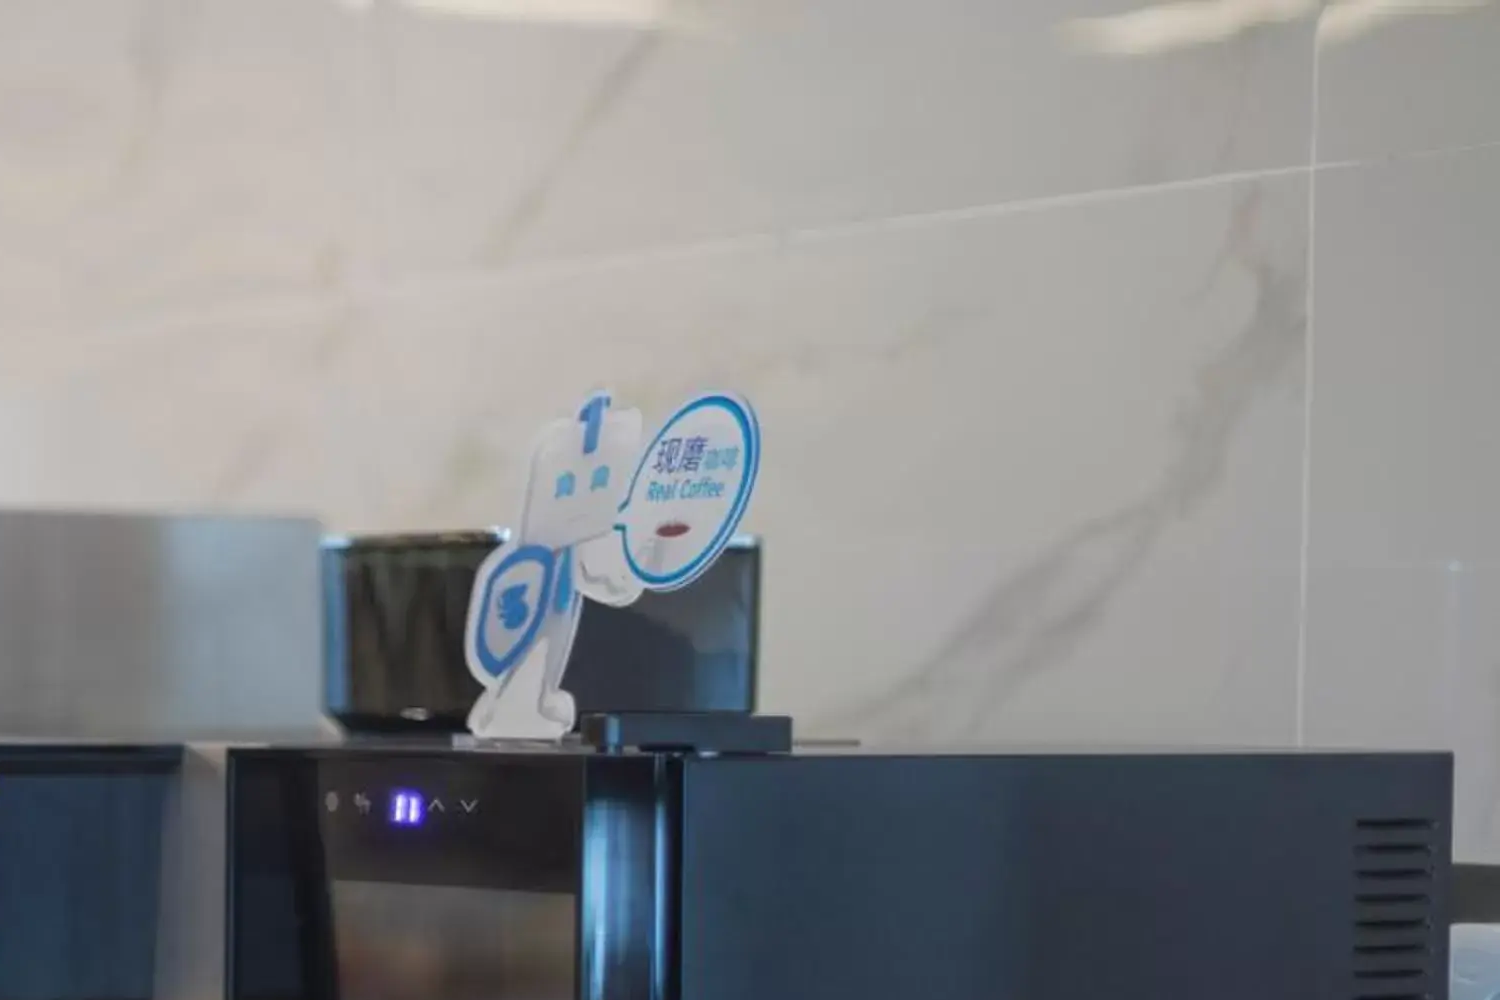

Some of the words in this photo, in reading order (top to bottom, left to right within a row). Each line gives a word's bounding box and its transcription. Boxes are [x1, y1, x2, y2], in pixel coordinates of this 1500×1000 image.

[652, 435, 739, 474] 现磨
[648, 479, 679, 502] Real
[681, 477, 725, 500] Coffee
